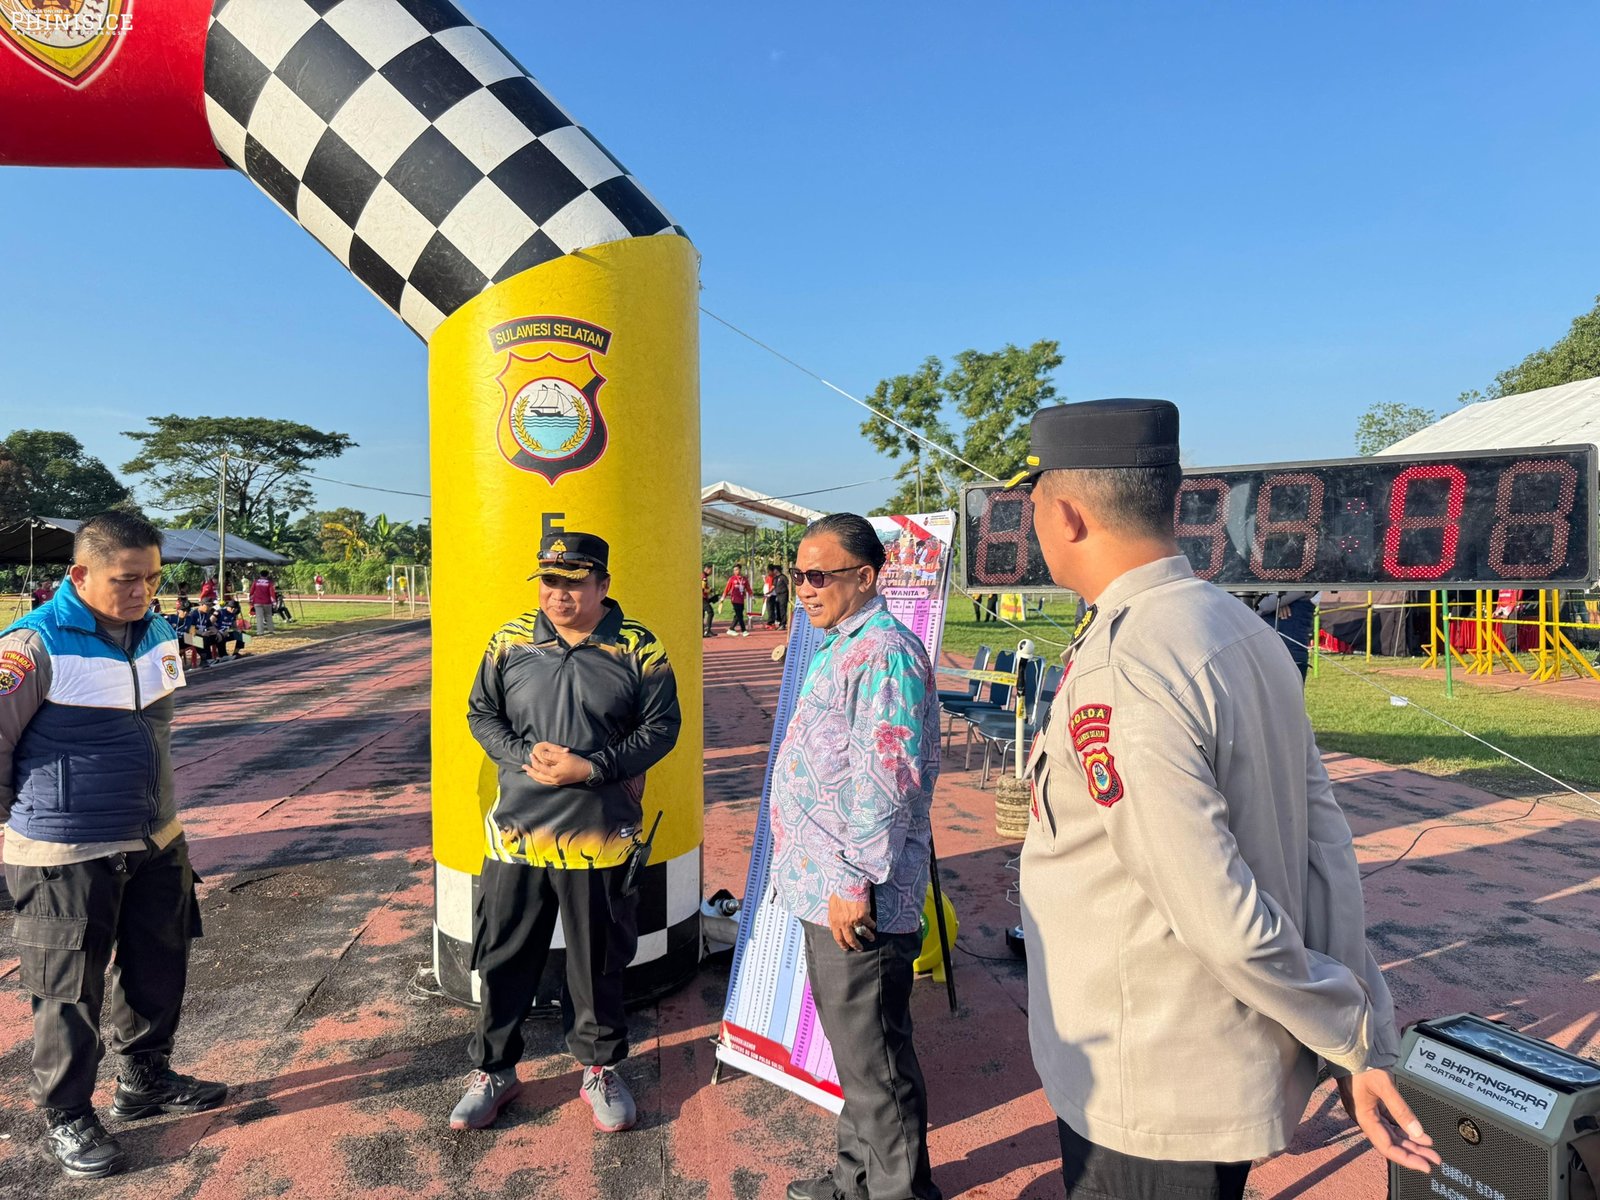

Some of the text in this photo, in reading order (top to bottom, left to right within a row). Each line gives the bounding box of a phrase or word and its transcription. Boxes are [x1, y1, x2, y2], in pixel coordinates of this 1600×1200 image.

[495, 323, 604, 348] SULAWESI SELATAN
[1419, 1047, 1548, 1110] V8 BHAYANGKARA
[1424, 1062, 1528, 1113] PORTABLE MANPACK
[1441, 1162, 1472, 1187] BIRO
